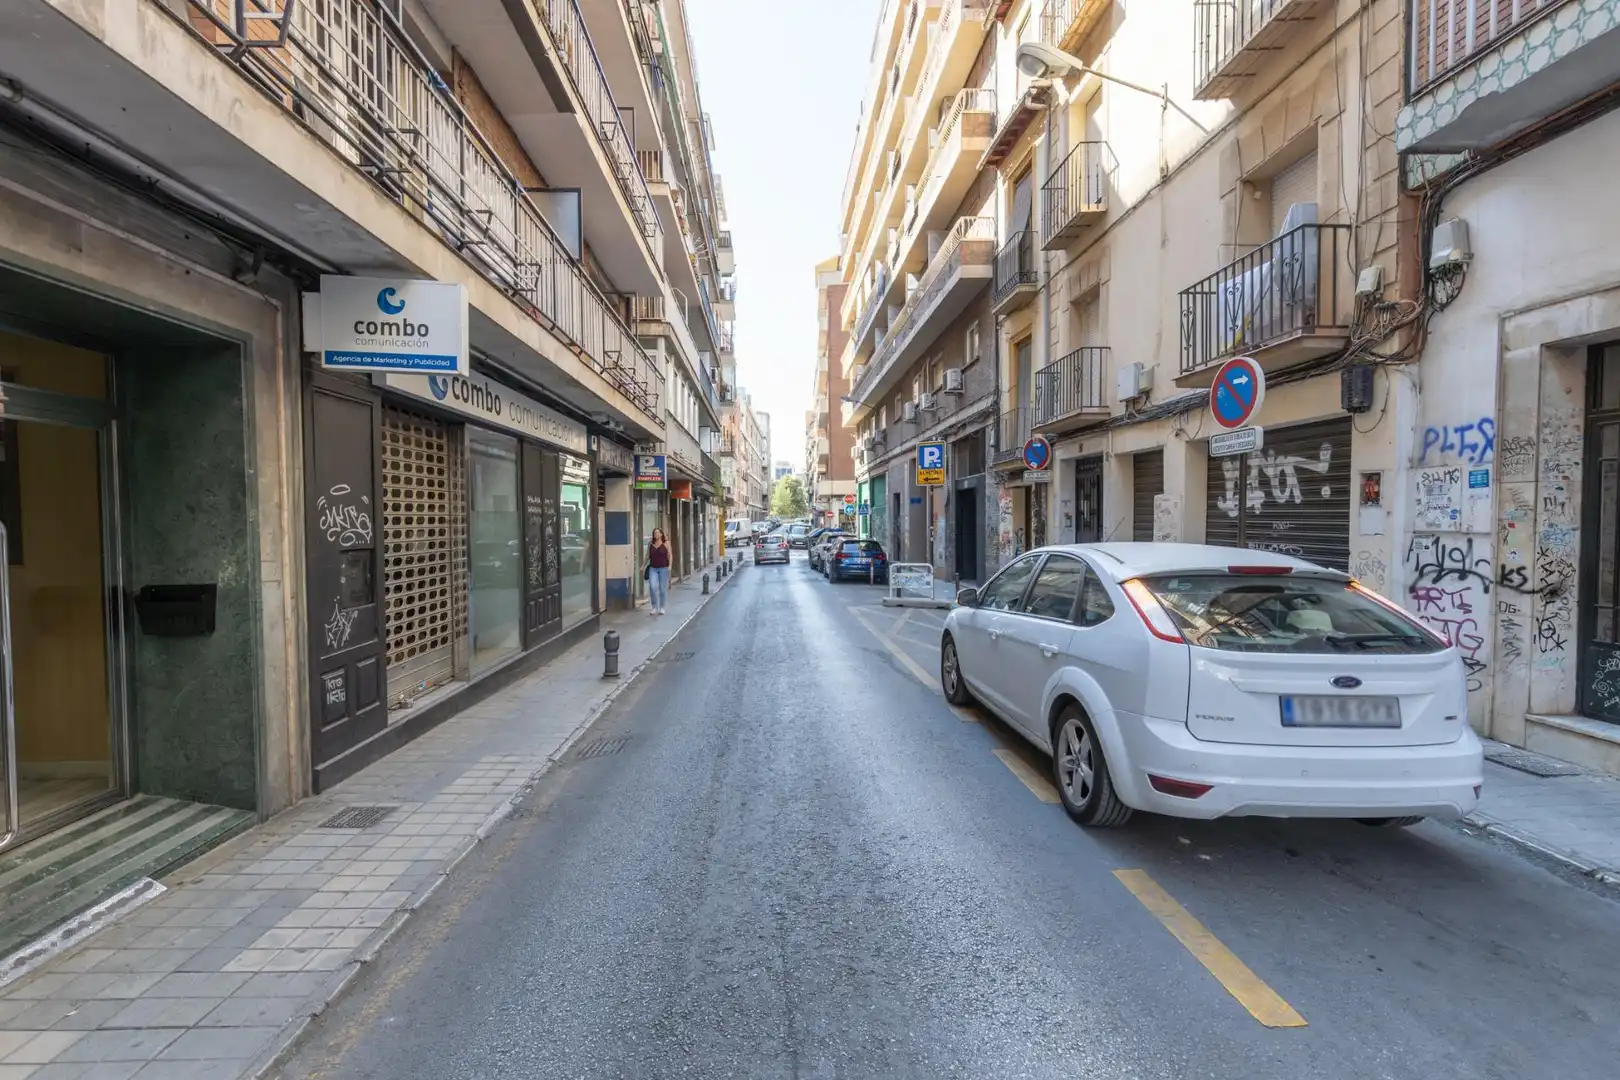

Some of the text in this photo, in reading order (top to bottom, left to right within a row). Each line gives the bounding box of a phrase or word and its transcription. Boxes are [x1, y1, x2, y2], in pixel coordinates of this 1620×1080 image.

[354, 318, 429, 337] combo
[355, 337, 429, 349] comunicación
[333, 355, 361, 364] Agencia
[373, 357, 407, 366] Marketing
[414, 358, 450, 367] Publicidad
[452, 376, 573, 444] combo comunicación
